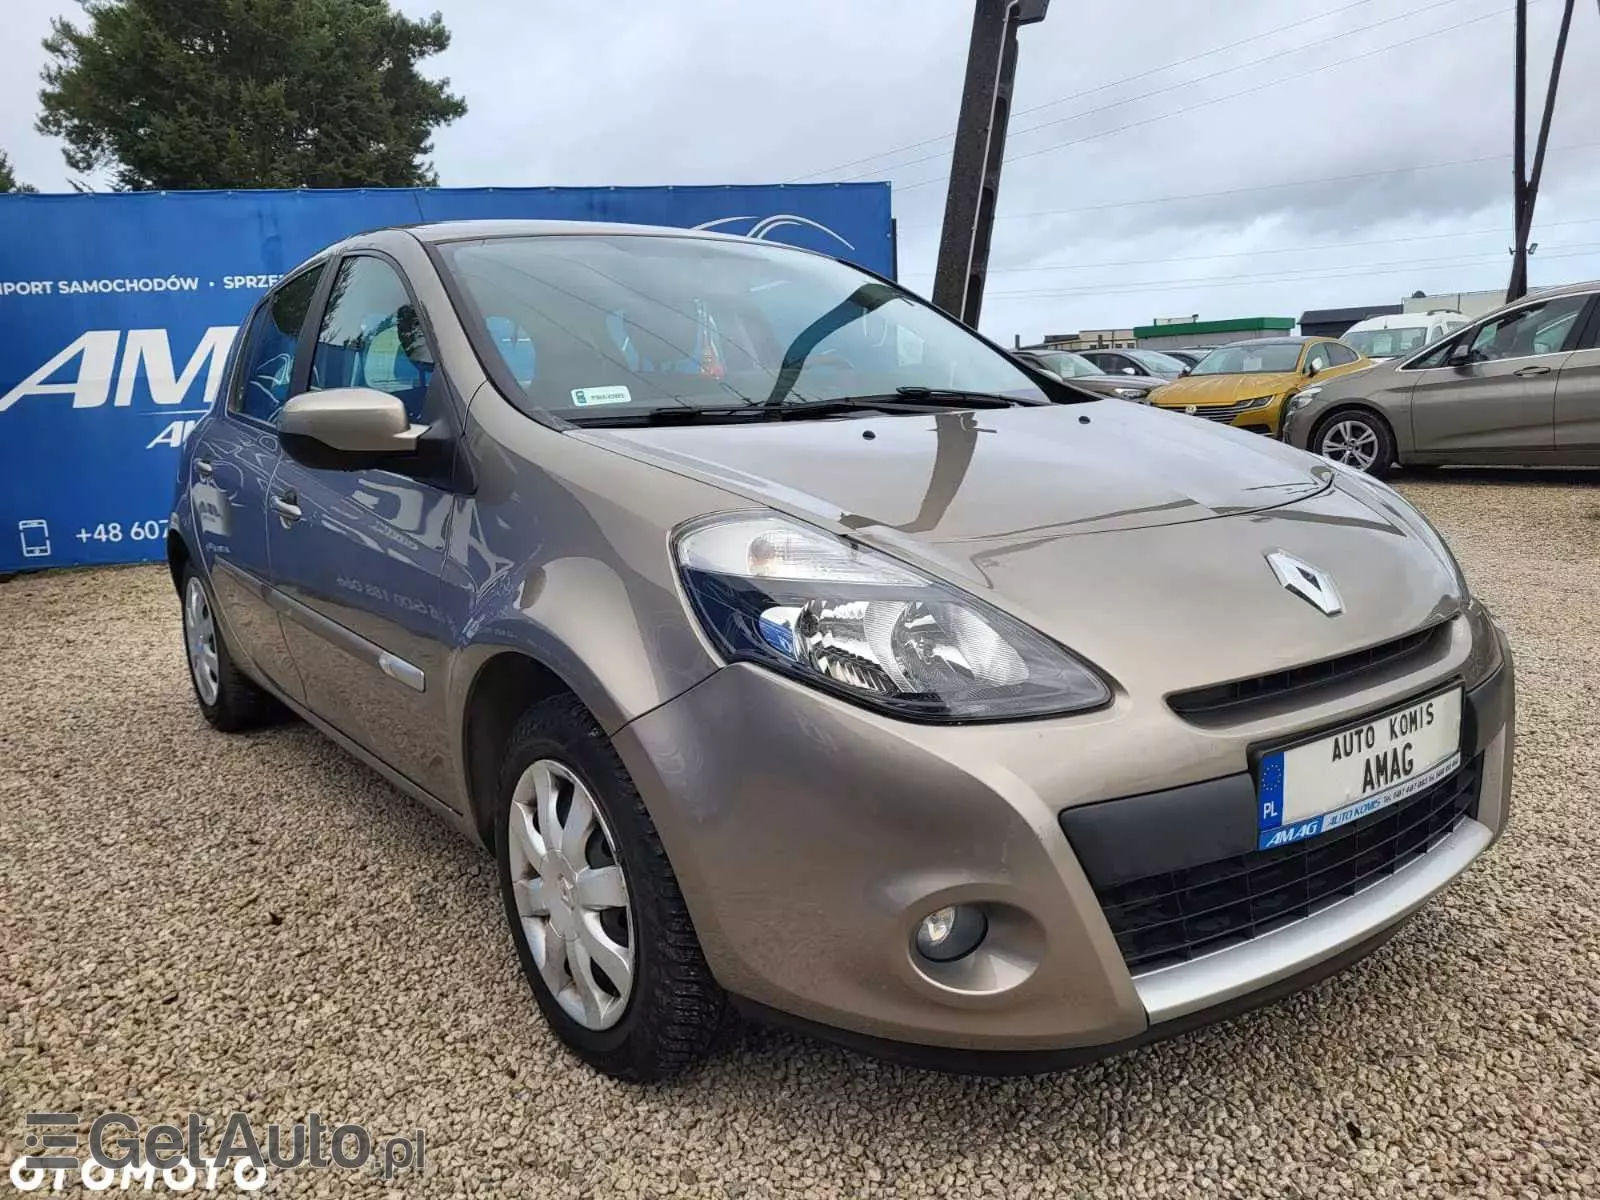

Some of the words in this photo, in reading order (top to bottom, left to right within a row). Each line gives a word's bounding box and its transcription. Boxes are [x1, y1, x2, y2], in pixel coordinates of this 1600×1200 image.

[0, 281, 53, 295] PORT
[58, 275, 199, 294] SAMOCHODÓW
[223, 274, 283, 289] SPRZE
[75, 522, 122, 543] +48
[130, 520, 169, 541] 607
[1332, 725, 1375, 762] AUTO
[1389, 703, 1434, 740] KOMIS
[1362, 742, 1413, 793] AMAG
[1263, 801, 1278, 819] PL
[1265, 821, 1320, 848] AMAG
[1328, 809, 1353, 826] AUTO
